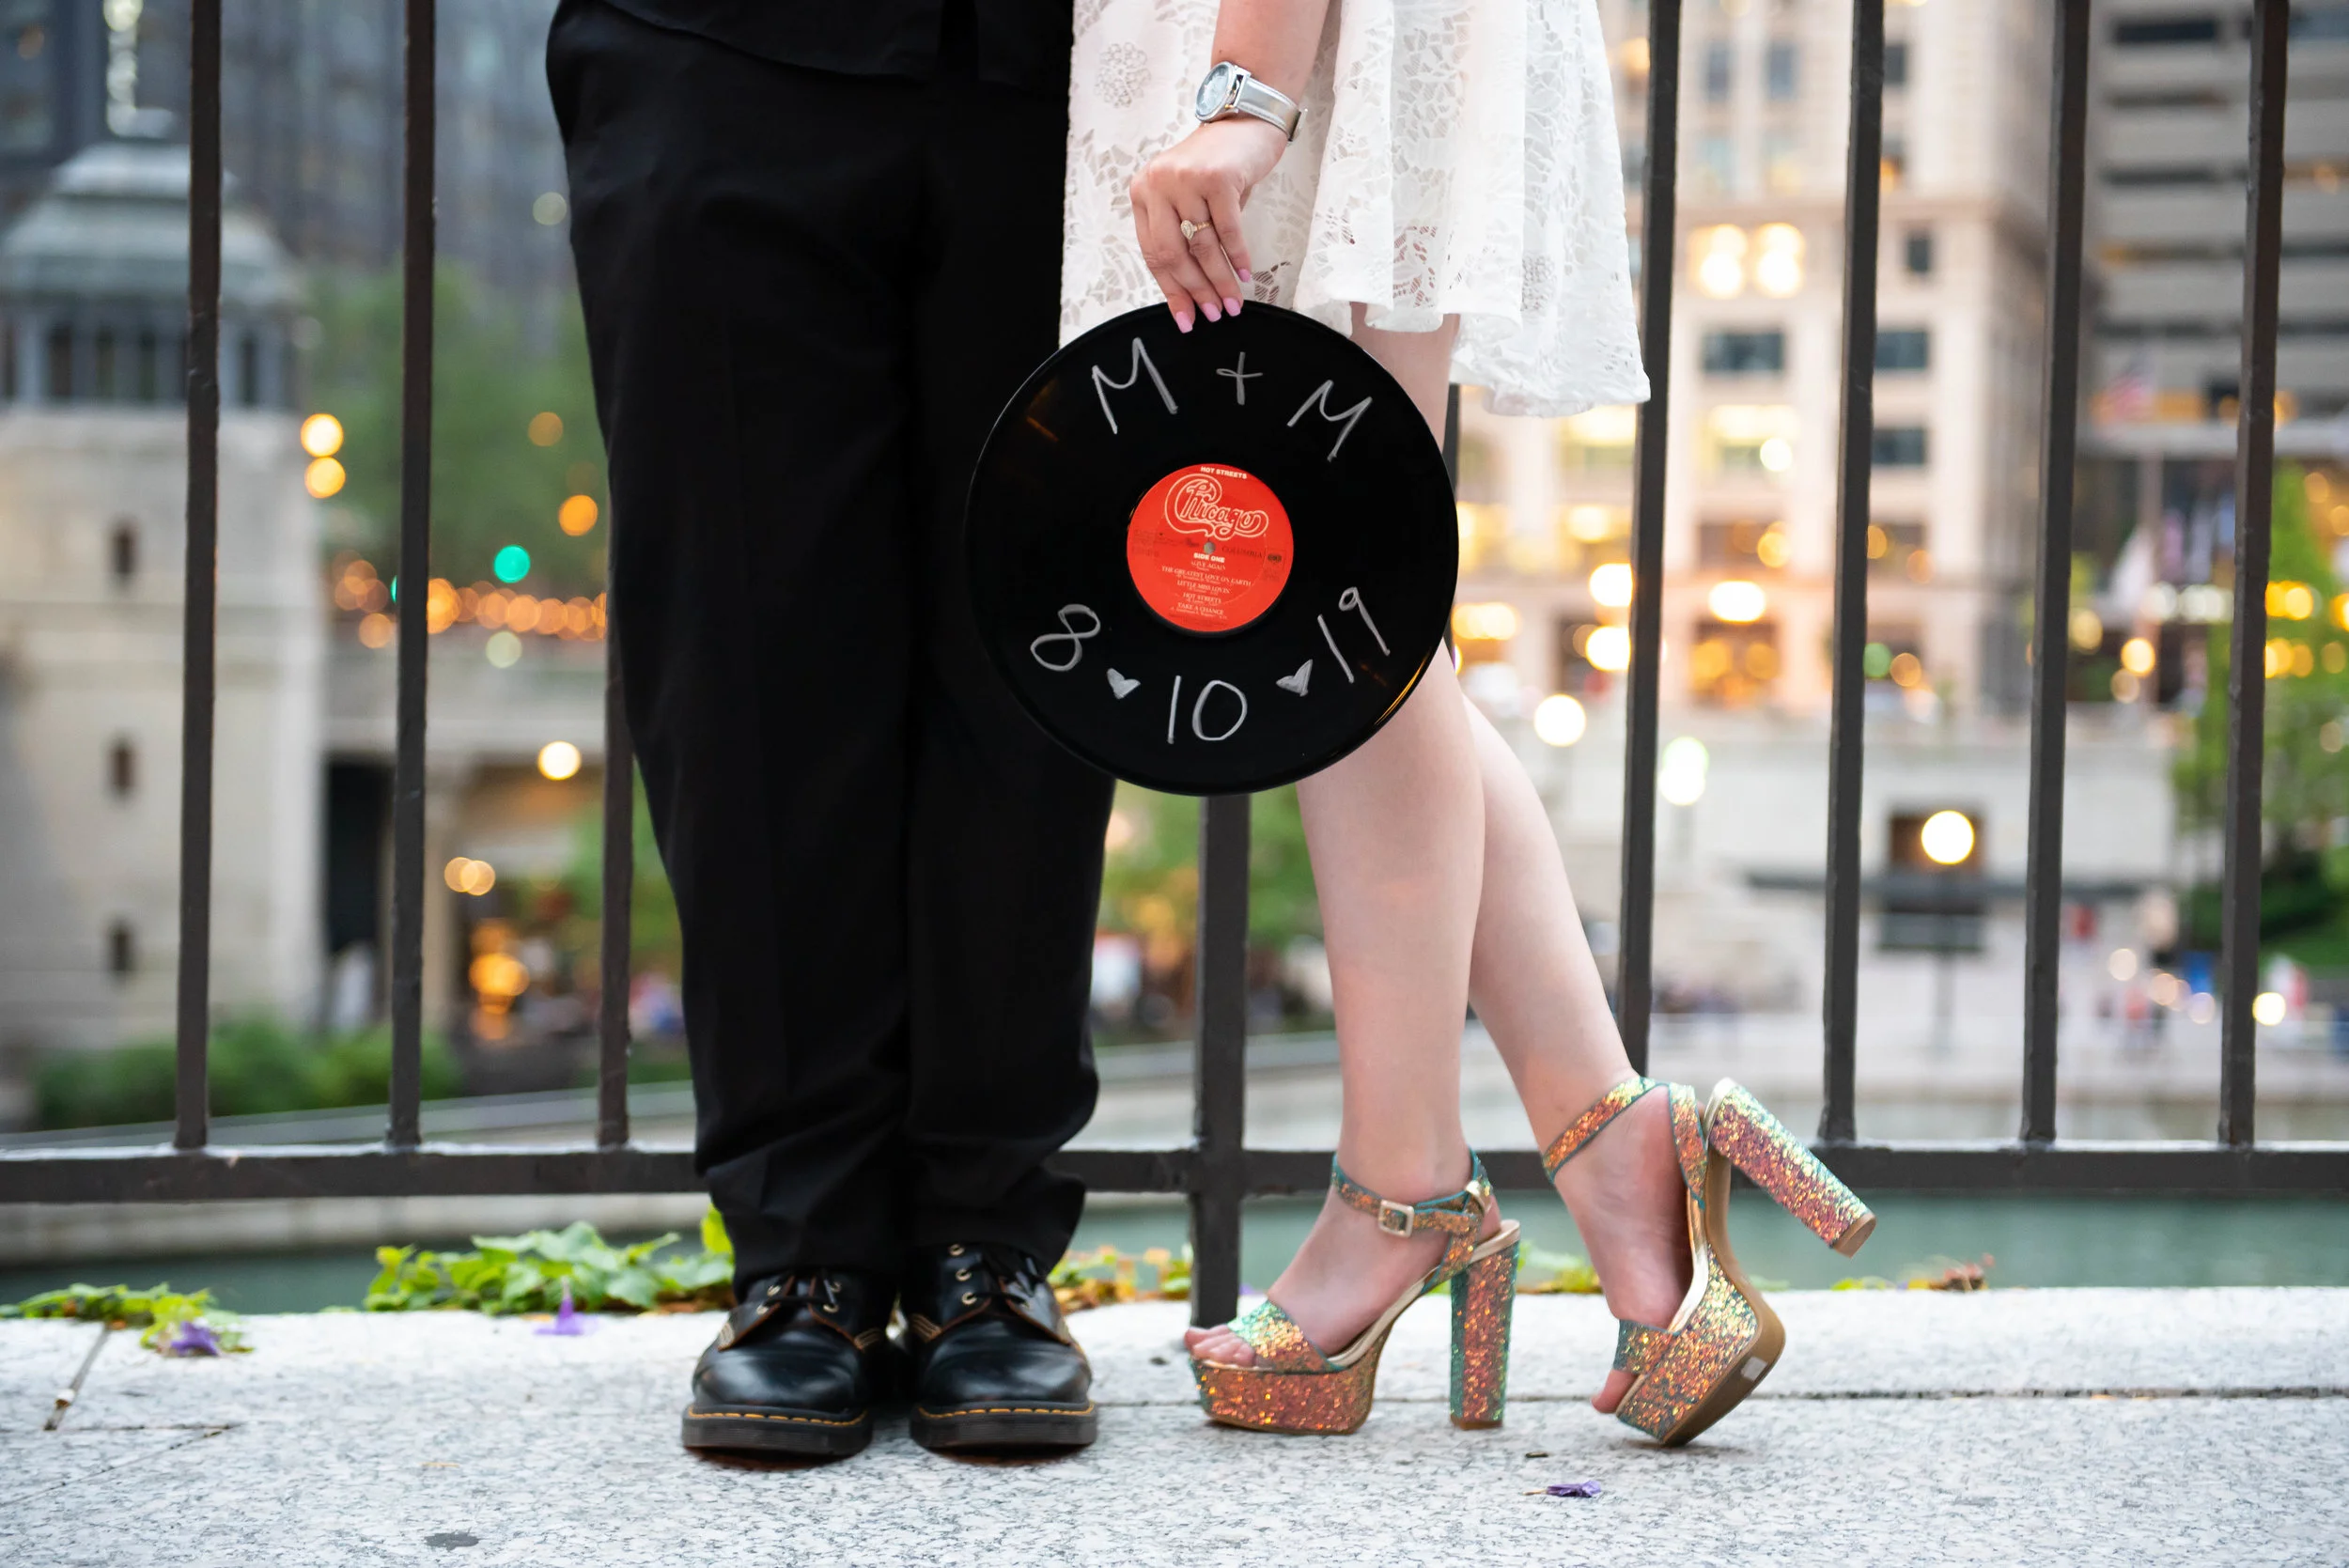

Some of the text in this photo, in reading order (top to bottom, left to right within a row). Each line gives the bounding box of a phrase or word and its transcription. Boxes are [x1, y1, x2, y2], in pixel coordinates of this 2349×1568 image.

[1092, 337, 1372, 460] M + M
[1200, 465, 1248, 480] HOT STREETS
[1164, 473, 1269, 541] Chicago
[1174, 567, 1204, 579] GREATEST
[1231, 578, 1252, 586] EARTH
[1177, 580, 1196, 588] LITTLE
[1197, 595, 1221, 603] STREETS
[1199, 607, 1224, 615] CHANCE
[1031, 587, 1390, 744] 8 10 19
